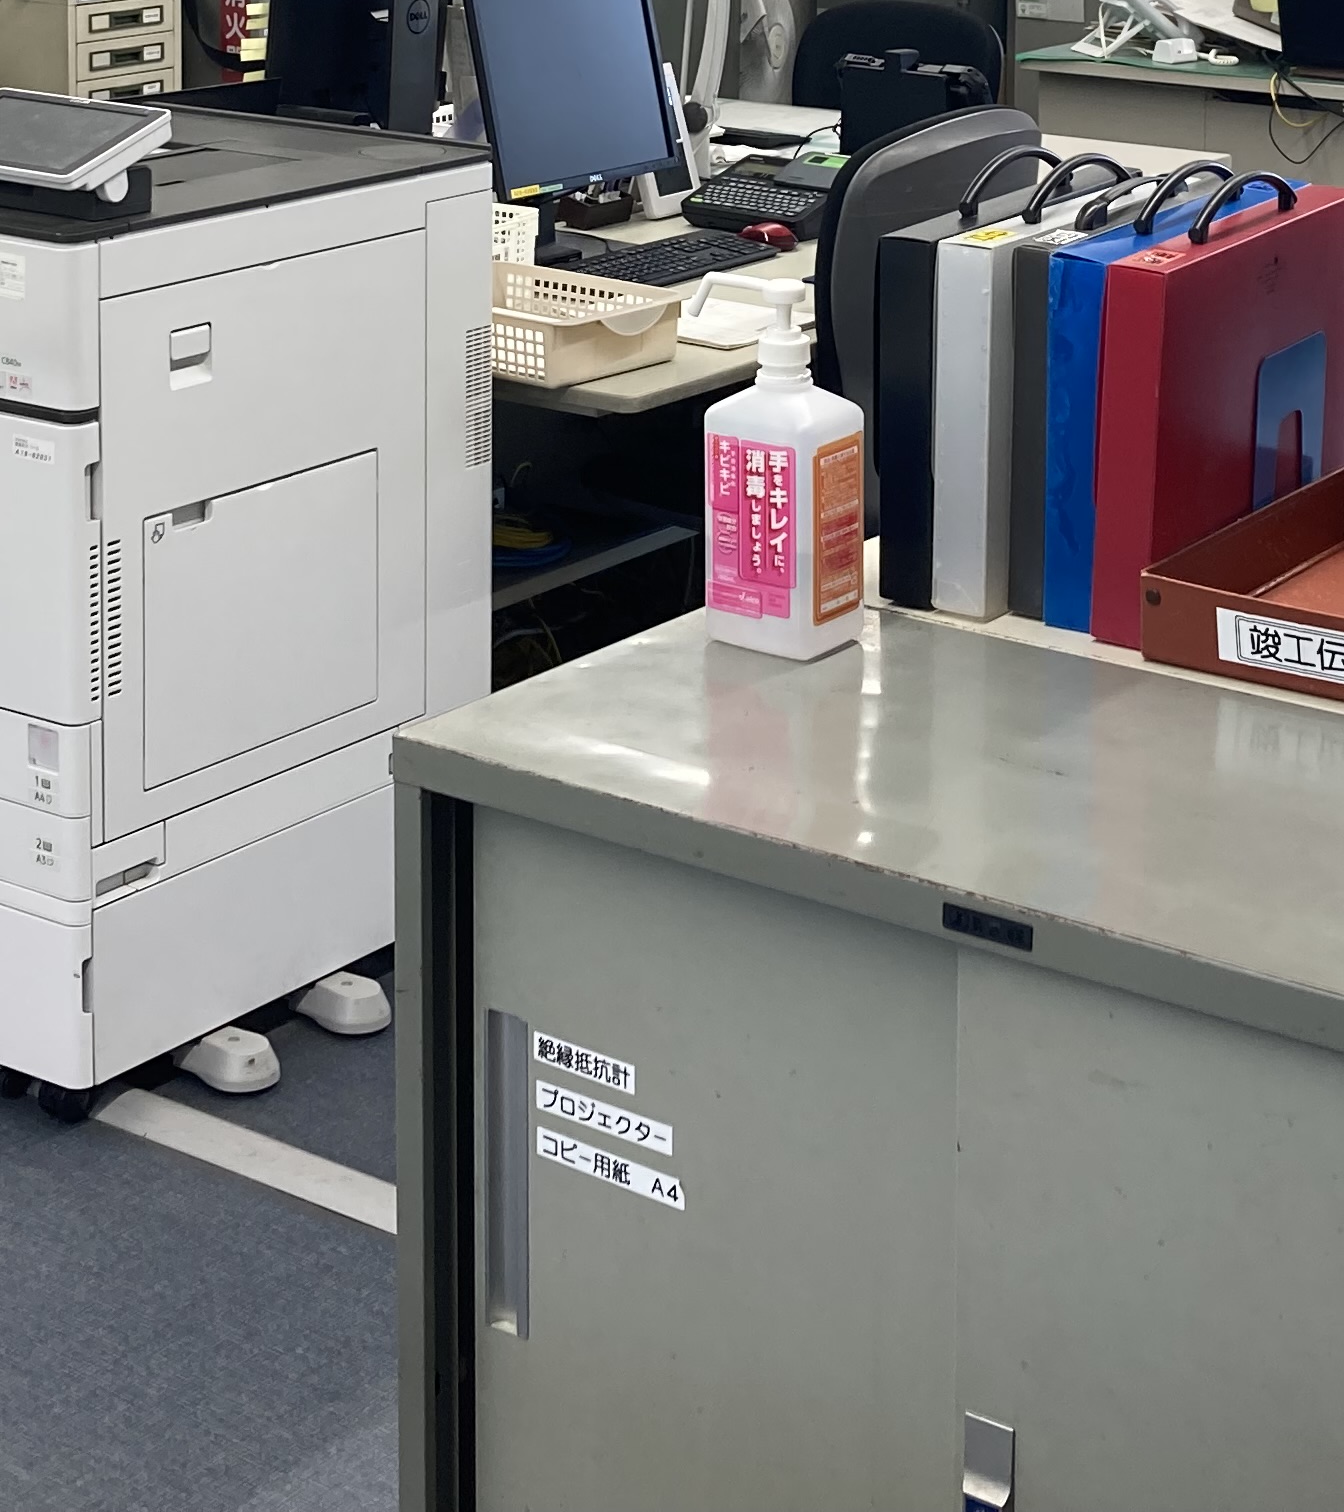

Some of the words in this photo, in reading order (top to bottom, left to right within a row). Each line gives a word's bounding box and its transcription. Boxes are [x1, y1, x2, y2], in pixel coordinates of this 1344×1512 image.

[538, 1037, 630, 1090] 絶縁抵抗計
[541, 1087, 667, 1143] プロジェクター
[543, 1134, 631, 1186] コピー用紙
[651, 1178, 679, 1202] A4
